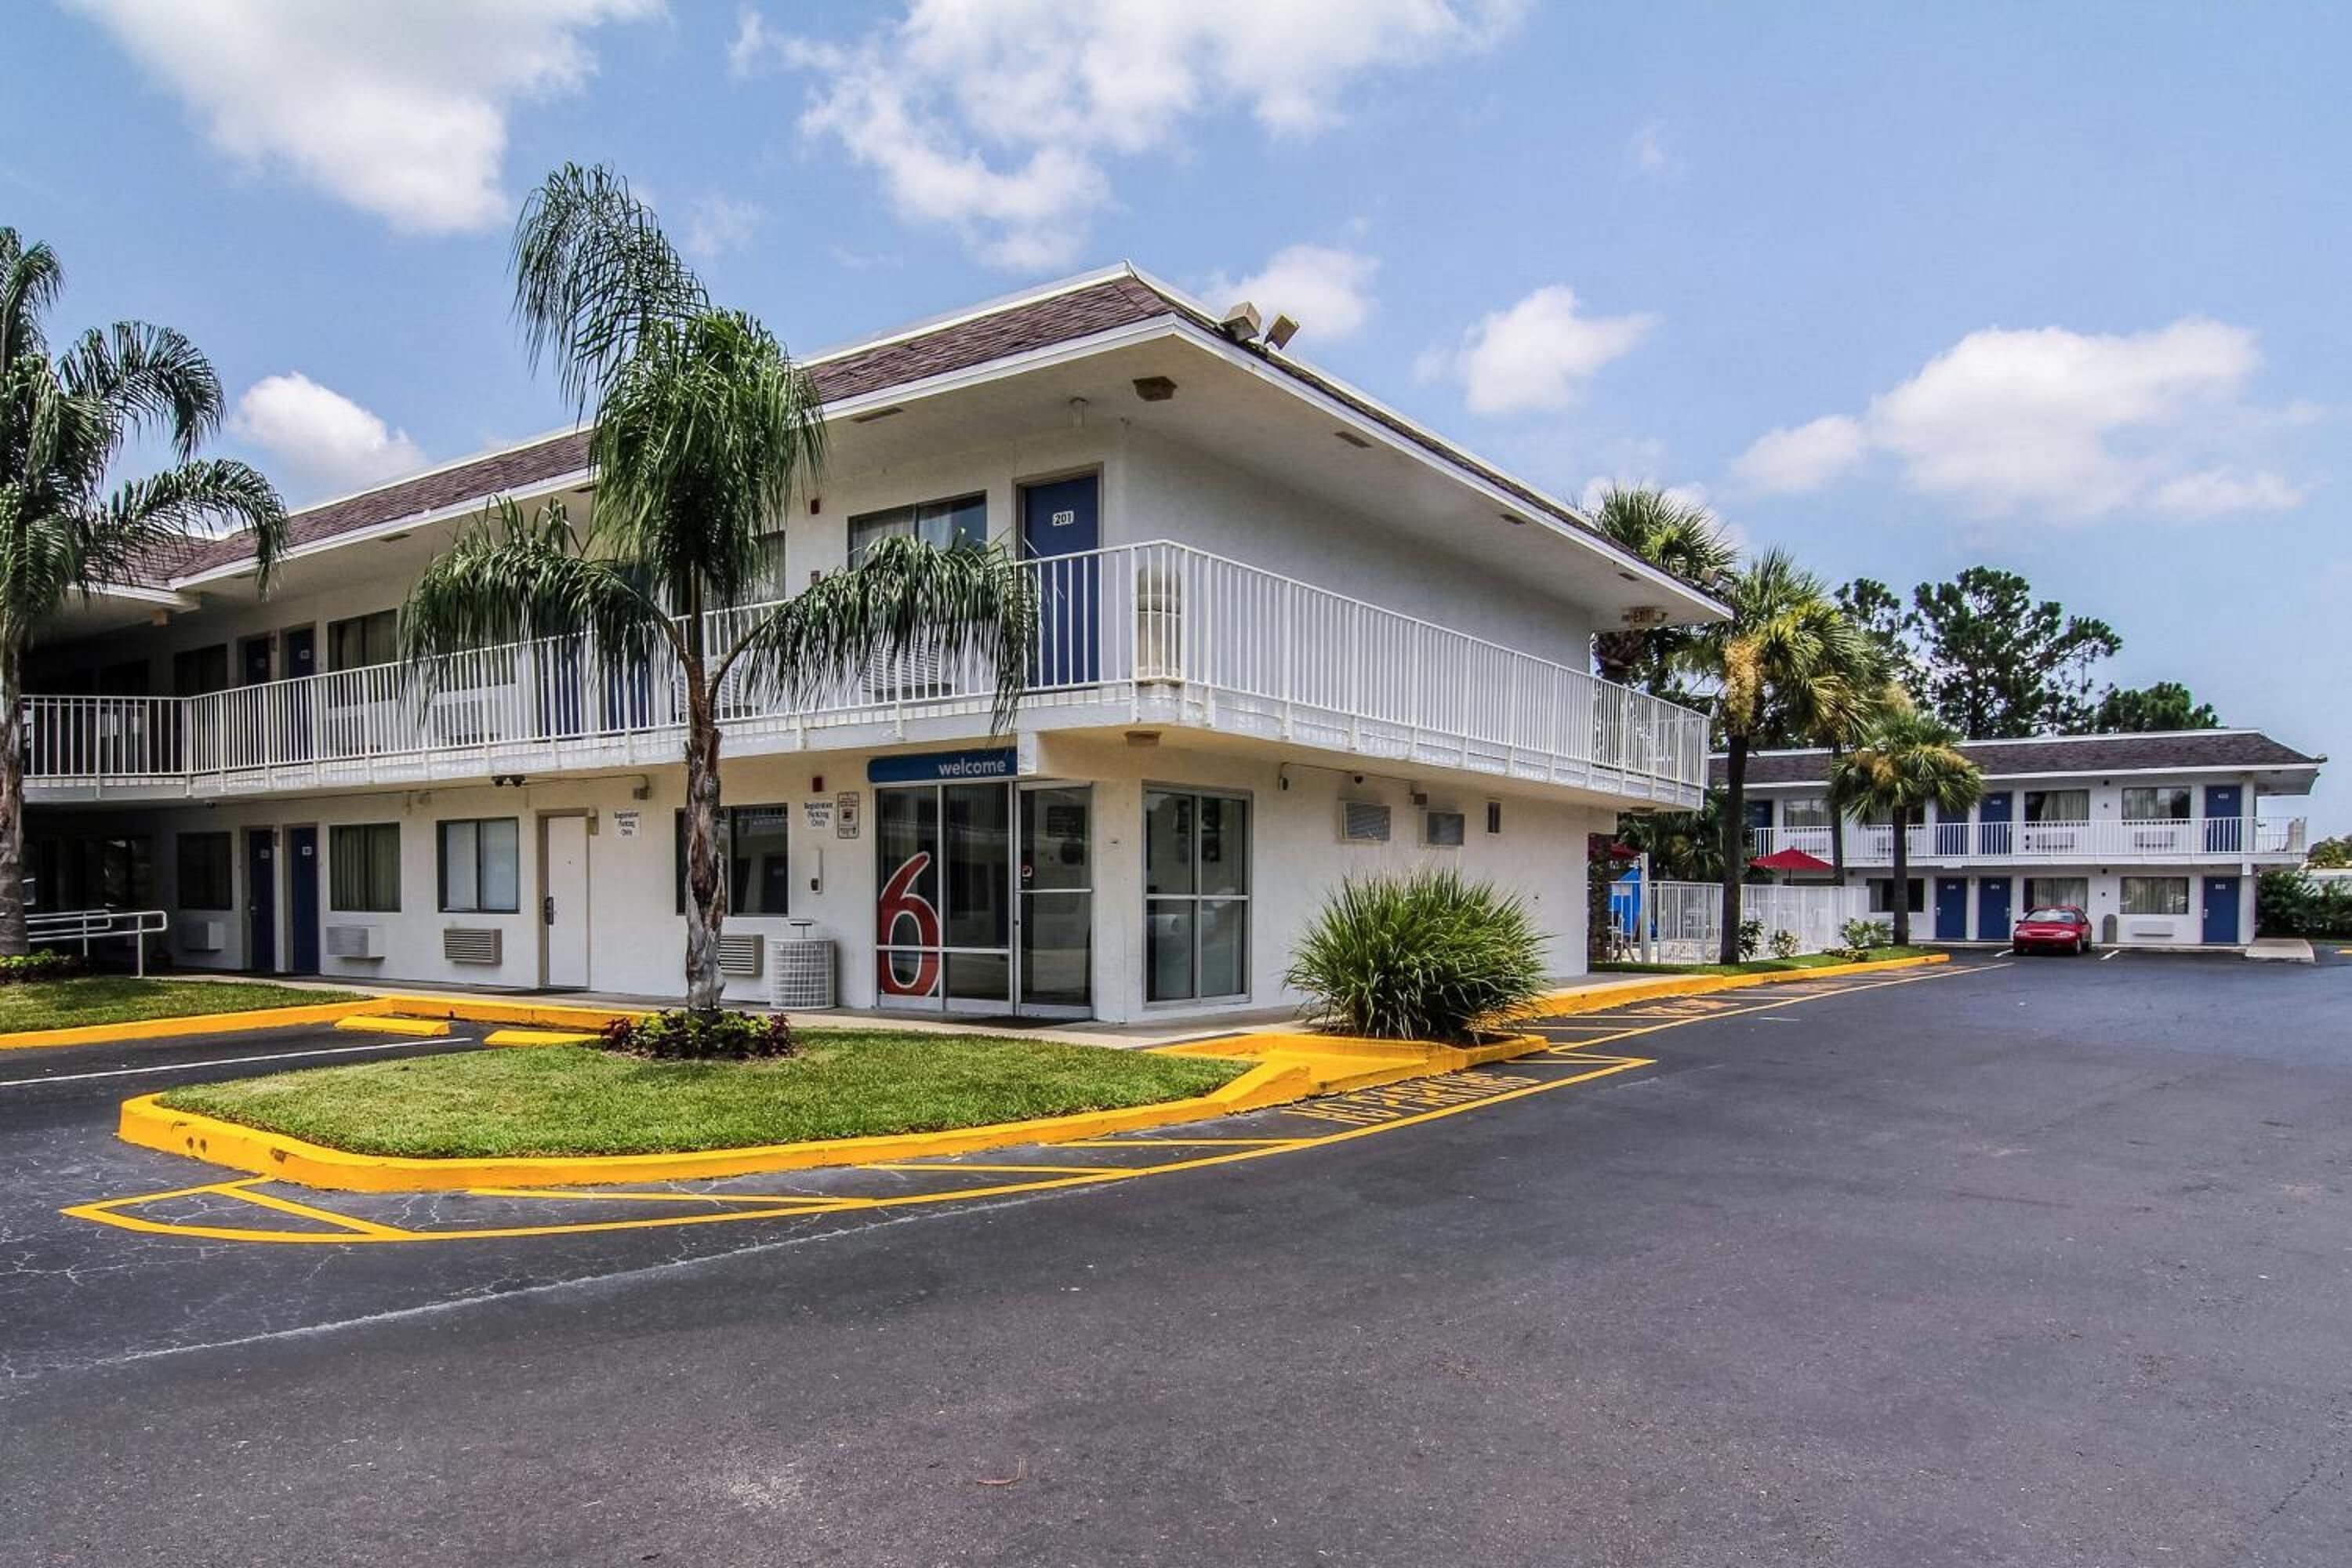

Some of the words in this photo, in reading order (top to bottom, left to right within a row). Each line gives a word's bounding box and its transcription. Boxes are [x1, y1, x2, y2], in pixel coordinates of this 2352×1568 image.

[1054, 513, 1072, 524] 201
[938, 757, 1007, 776] welcome
[880, 851, 941, 996] 6
